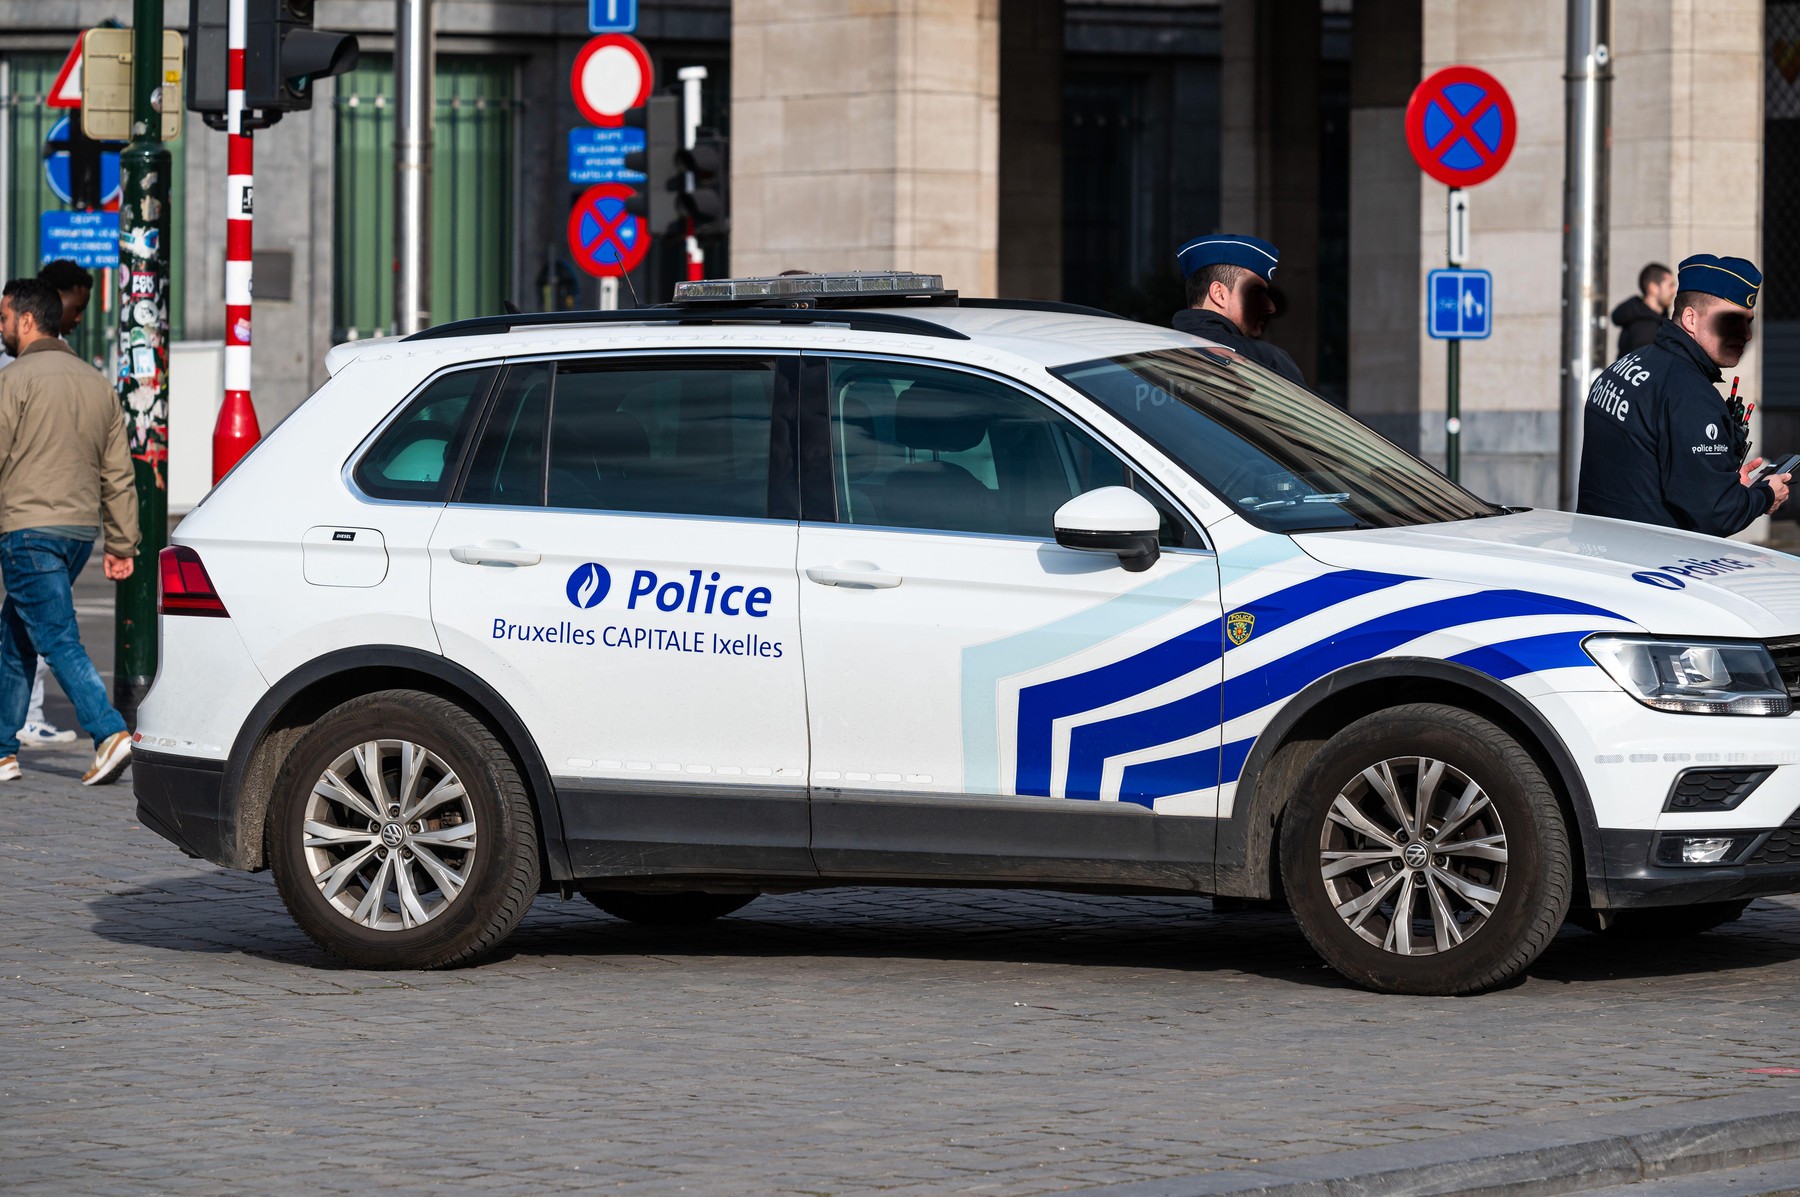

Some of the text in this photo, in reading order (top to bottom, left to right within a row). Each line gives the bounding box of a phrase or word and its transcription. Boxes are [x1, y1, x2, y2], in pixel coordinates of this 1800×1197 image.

[1588, 377, 1629, 422] Politie
[1659, 557, 1755, 580] Police
[627, 569, 773, 617] Police
[492, 618, 783, 658] Bruxelles CAPITALE Ixelles
